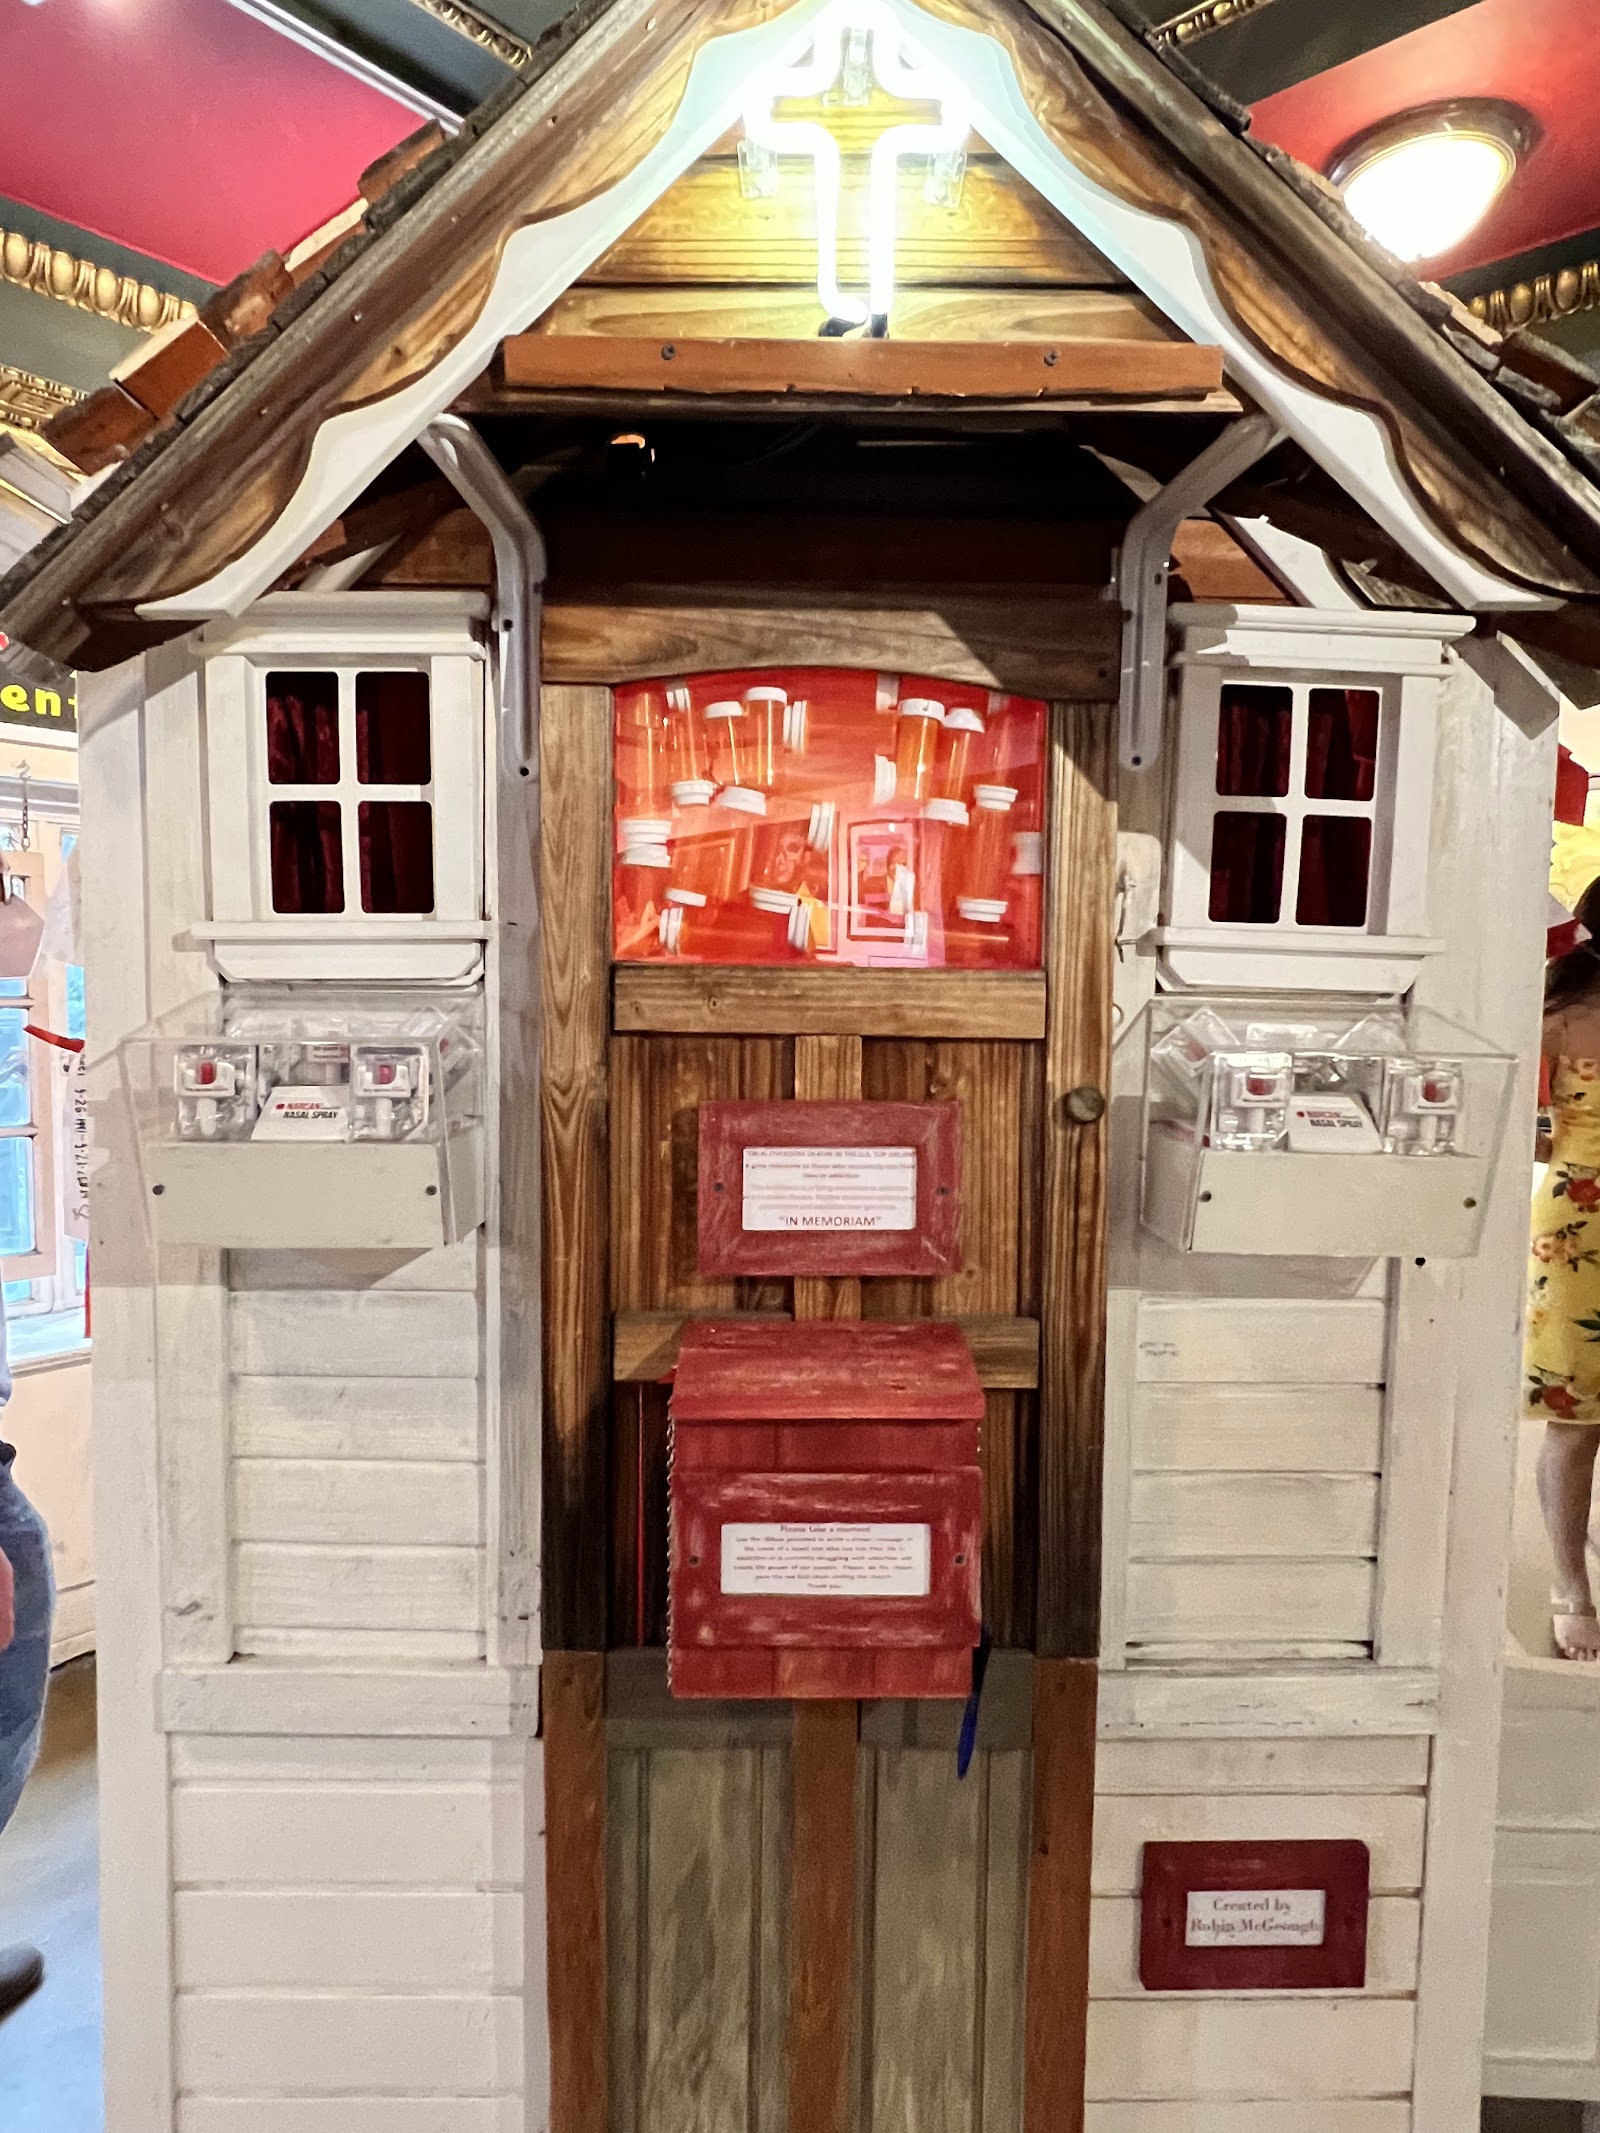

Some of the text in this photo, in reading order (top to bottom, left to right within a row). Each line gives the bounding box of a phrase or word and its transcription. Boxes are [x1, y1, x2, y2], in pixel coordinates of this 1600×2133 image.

[283, 1110, 339, 1119] NASAL SPRAY
[779, 1216, 882, 1226] "IN MEMORIAM"
[1213, 1898, 1292, 1915] Created by
